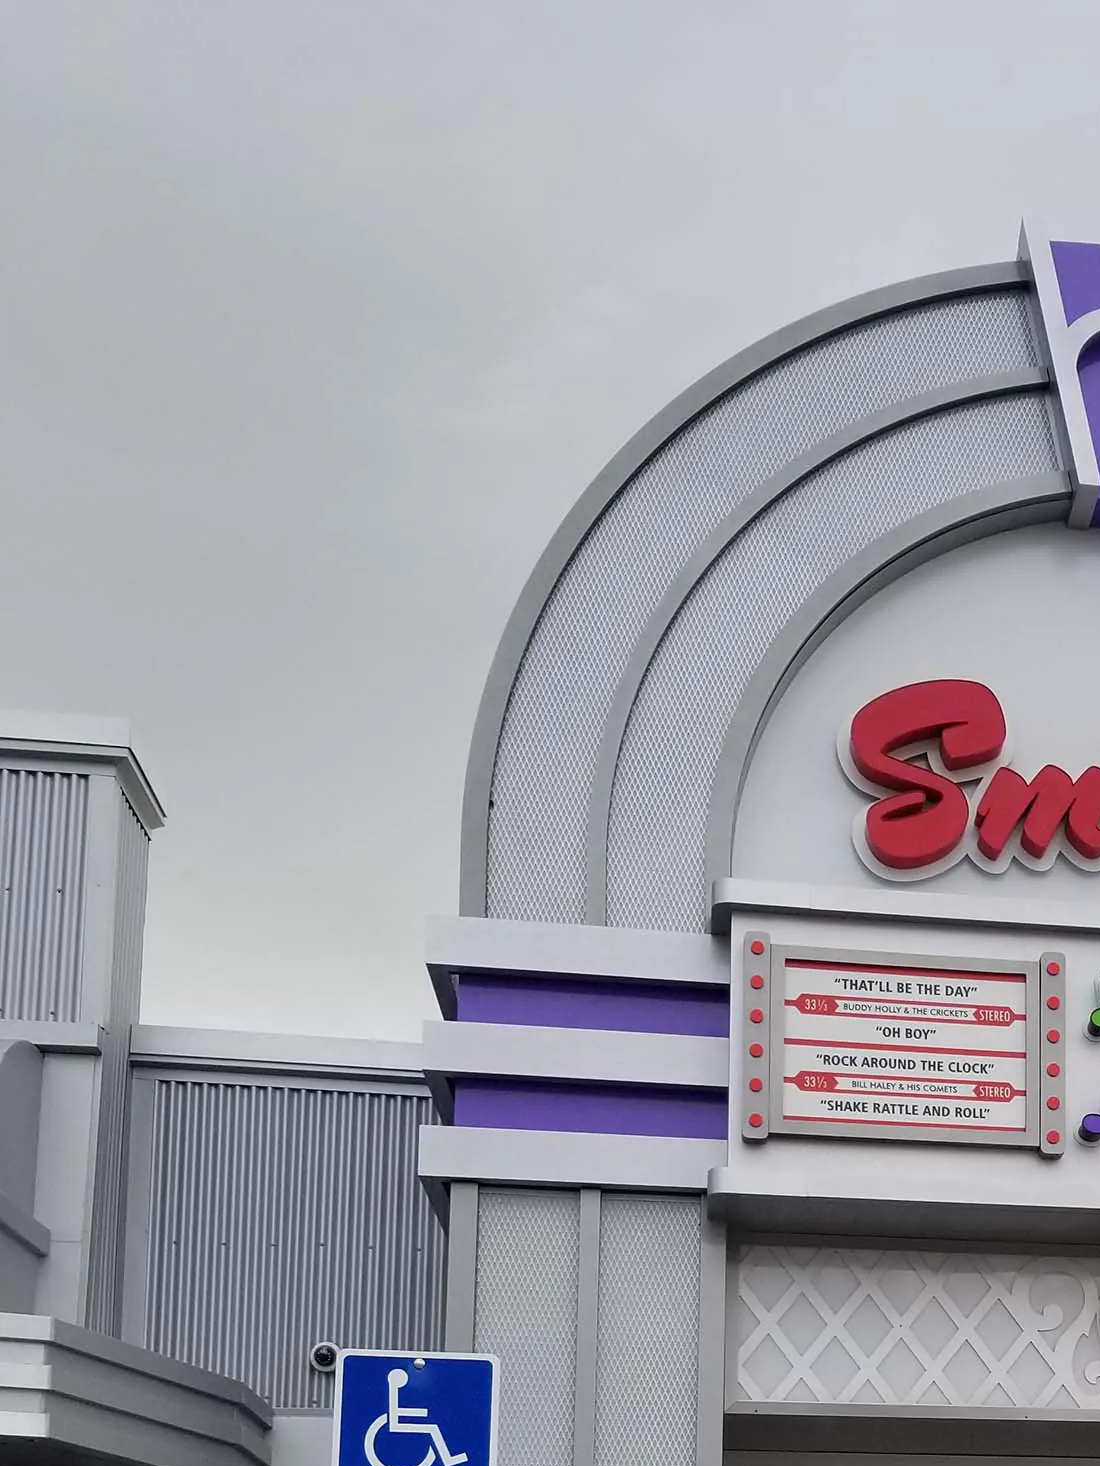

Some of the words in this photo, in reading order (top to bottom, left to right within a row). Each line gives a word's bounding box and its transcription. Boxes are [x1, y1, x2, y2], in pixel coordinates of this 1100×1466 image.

[834, 977, 893, 993] "THAT'LL
[896, 982, 913, 994] BE
[915, 983, 941, 996] THE
[945, 985, 978, 998] DAY"
[843, 1003, 872, 1012] BUDDY
[875, 1005, 901, 1013] HOLLY
[930, 1009, 968, 1017] CRICKETS
[980, 1008, 1011, 1022] STEREO
[875, 1026, 901, 1039] "OH
[905, 1027, 937, 1040] BOY"
[816, 1053, 858, 1068] "ROCK
[860, 1056, 917, 1071] AROUND
[919, 1059, 945, 1072] THE
[947, 1061, 995, 1075] CLOCK"
[870, 1082, 896, 1090] HALEY
[923, 1084, 957, 1093] COMETS
[980, 1084, 1011, 1098] STEREO
[820, 1099, 869, 1113] "SHAKE
[872, 1102, 919, 1116] RATTLE
[922, 1105, 951, 1118] AND
[954, 1106, 991, 1119] ROLL"
